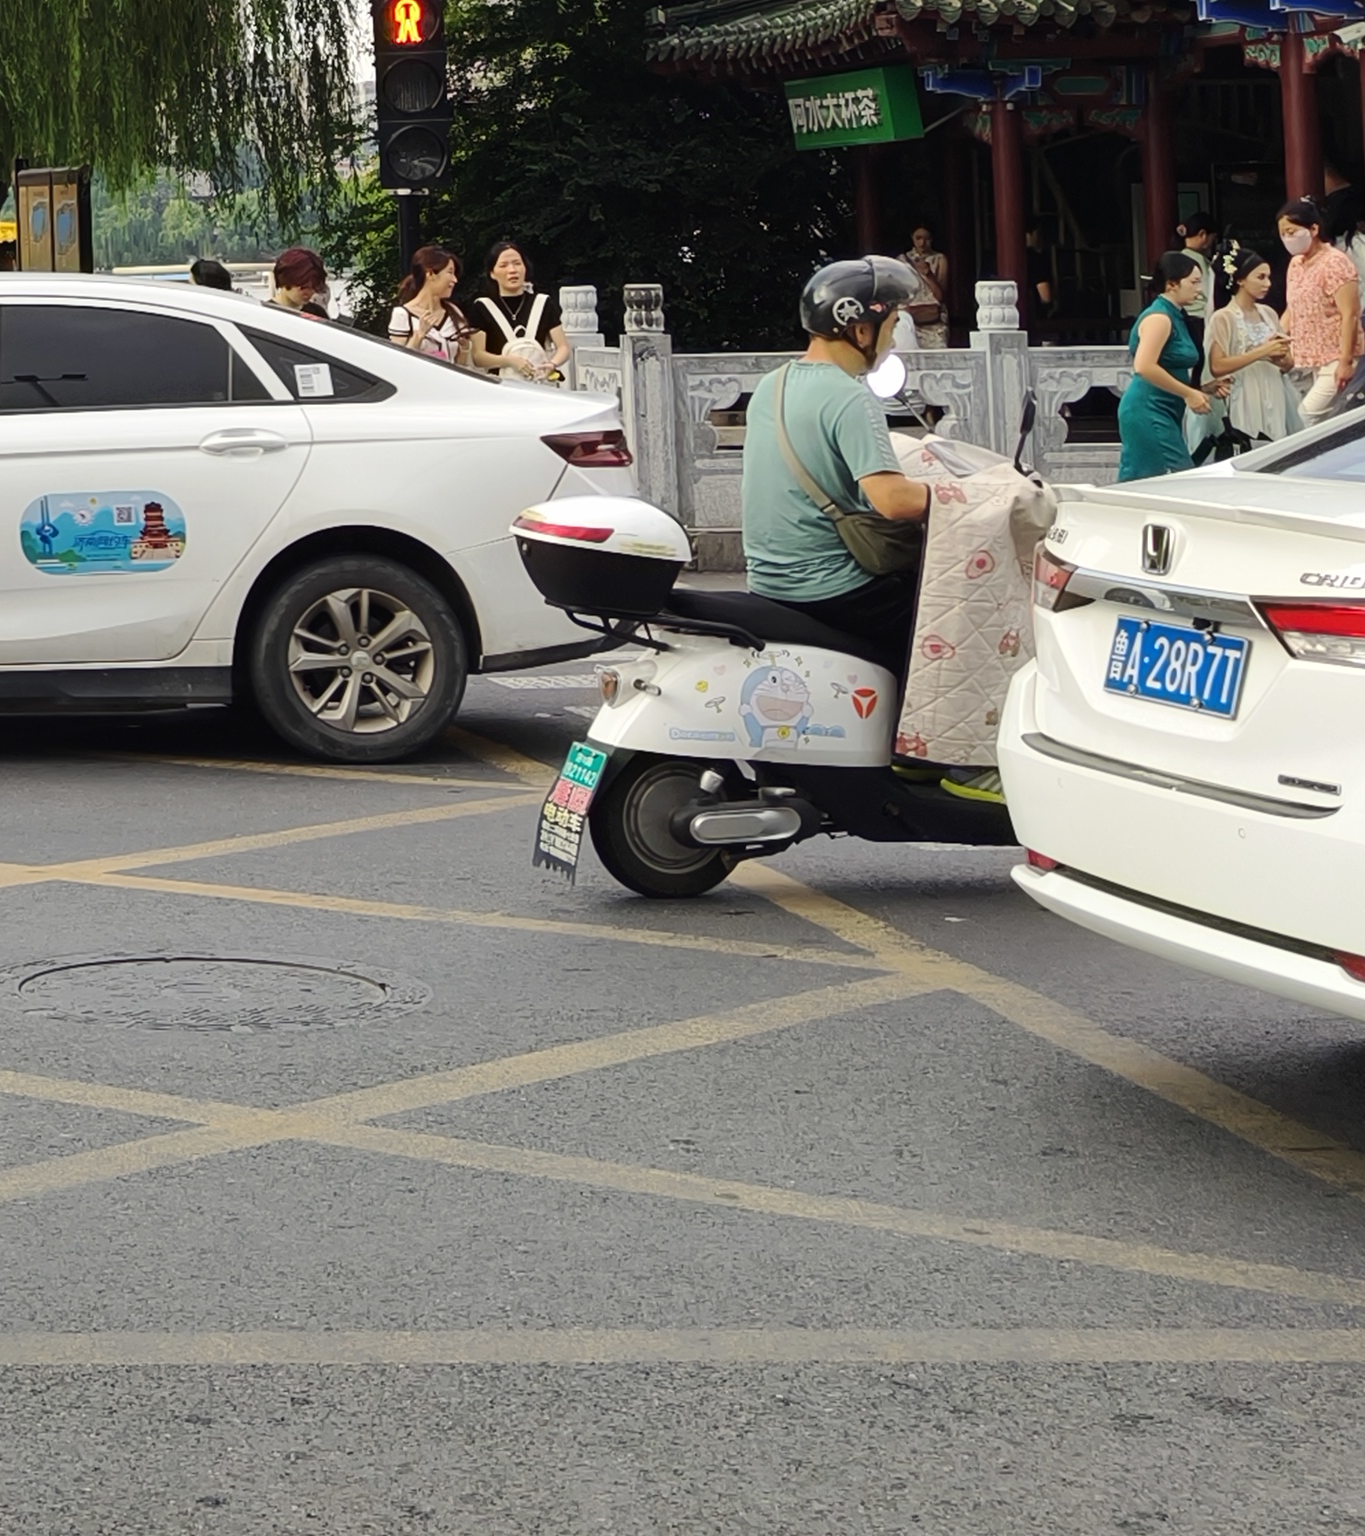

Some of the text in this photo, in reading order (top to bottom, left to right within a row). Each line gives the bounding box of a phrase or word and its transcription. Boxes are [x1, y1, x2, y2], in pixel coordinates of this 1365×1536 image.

[788, 87, 880, 134] 阿水大杯茶
[1109, 628, 1241, 704] 鲁A·28R7T
